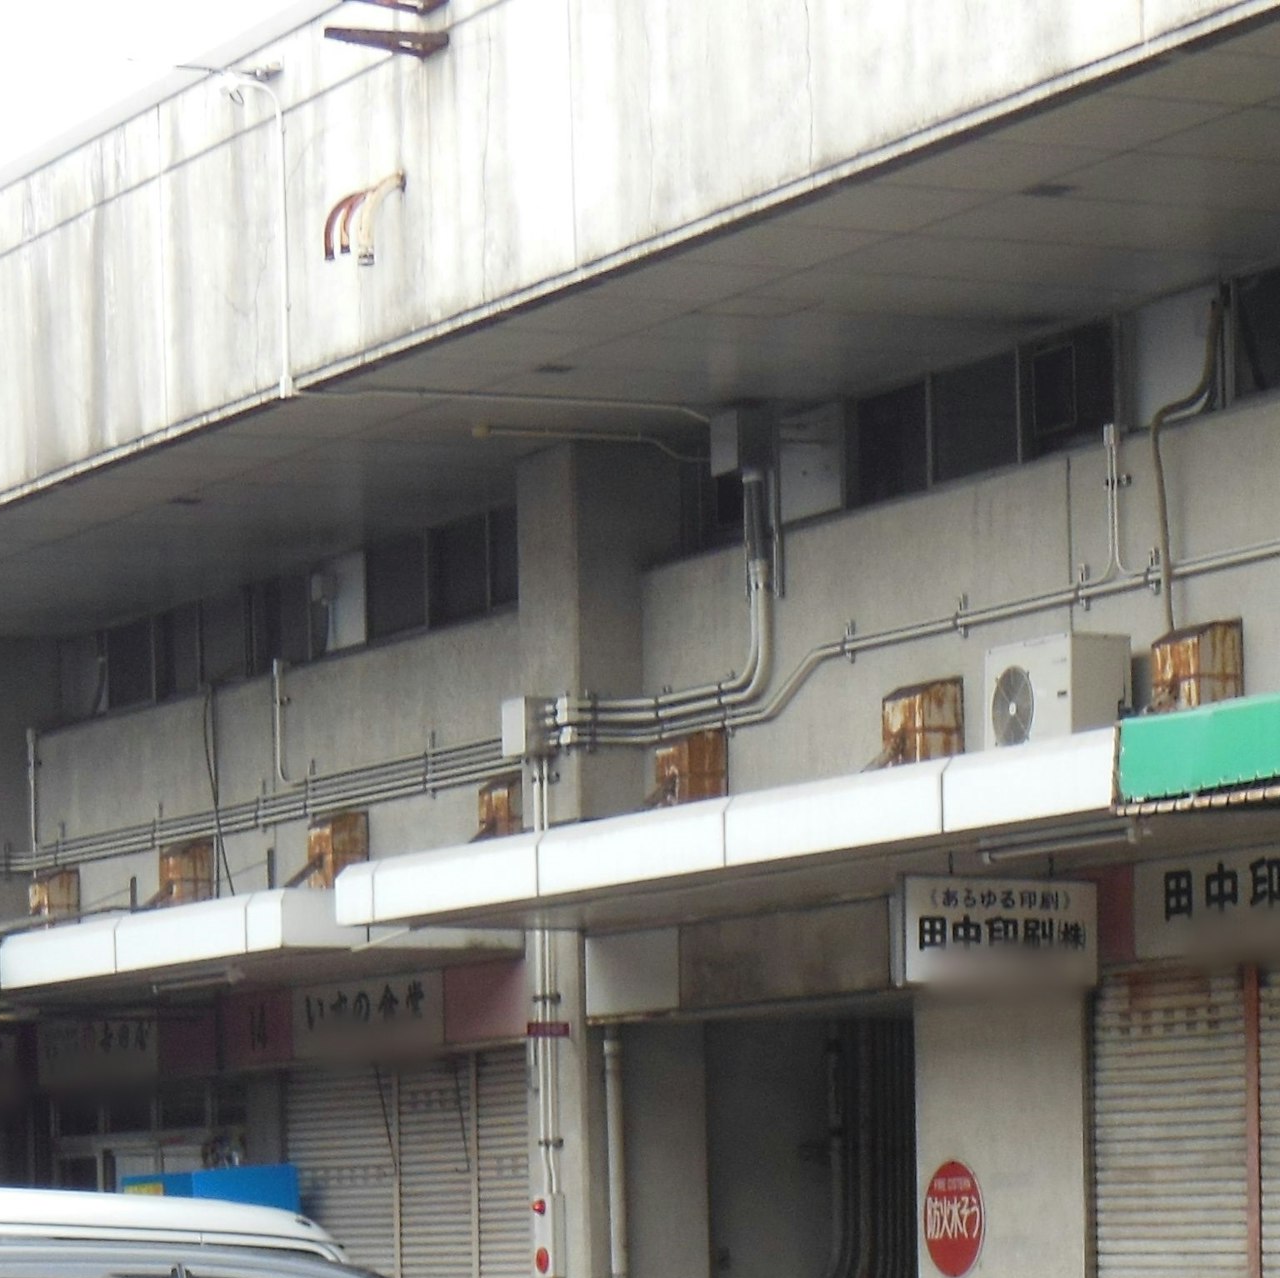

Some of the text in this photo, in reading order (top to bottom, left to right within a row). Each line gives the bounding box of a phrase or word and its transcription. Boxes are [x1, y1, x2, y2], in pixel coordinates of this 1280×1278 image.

[926, 1196, 980, 1240] 防火水そう
